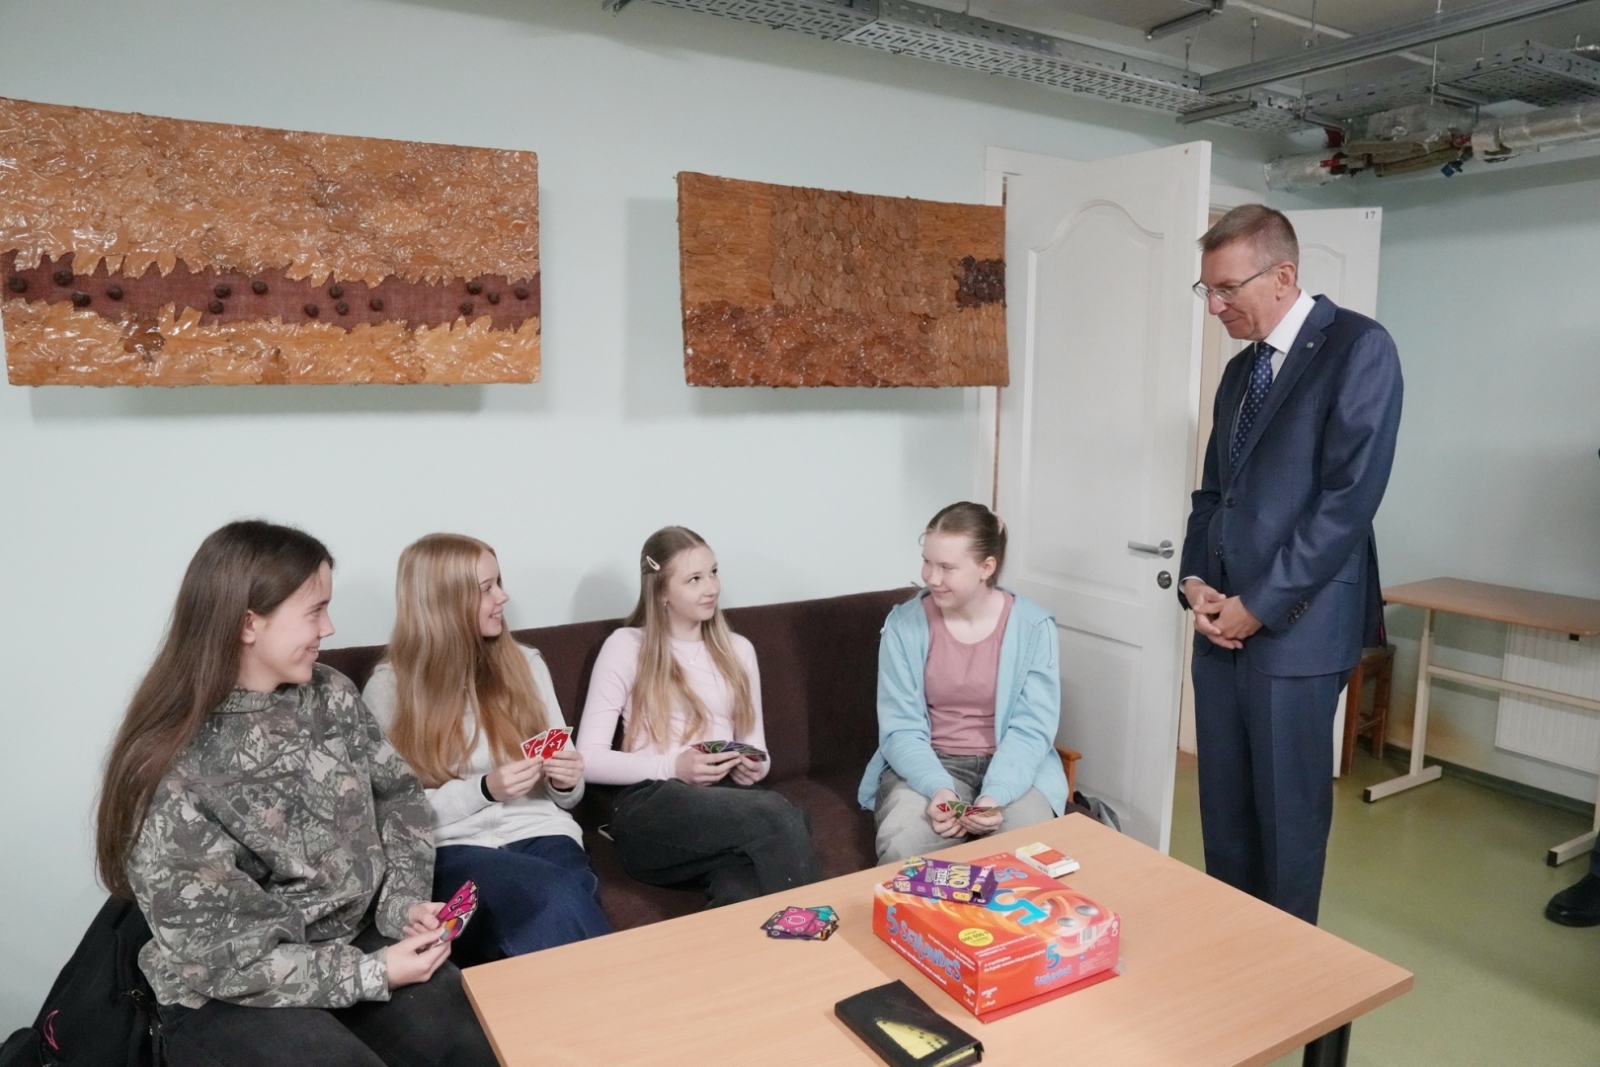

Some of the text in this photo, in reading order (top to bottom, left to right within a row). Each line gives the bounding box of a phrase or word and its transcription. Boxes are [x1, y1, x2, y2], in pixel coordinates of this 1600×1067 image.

[1365, 210, 1376, 220] 17
[948, 864, 971, 889] UNO
[885, 903, 900, 936] 5
[900, 919, 962, 982] SEKUNDES
[1045, 943, 1062, 970] 5
[1034, 963, 1074, 988] SEKUNDES
